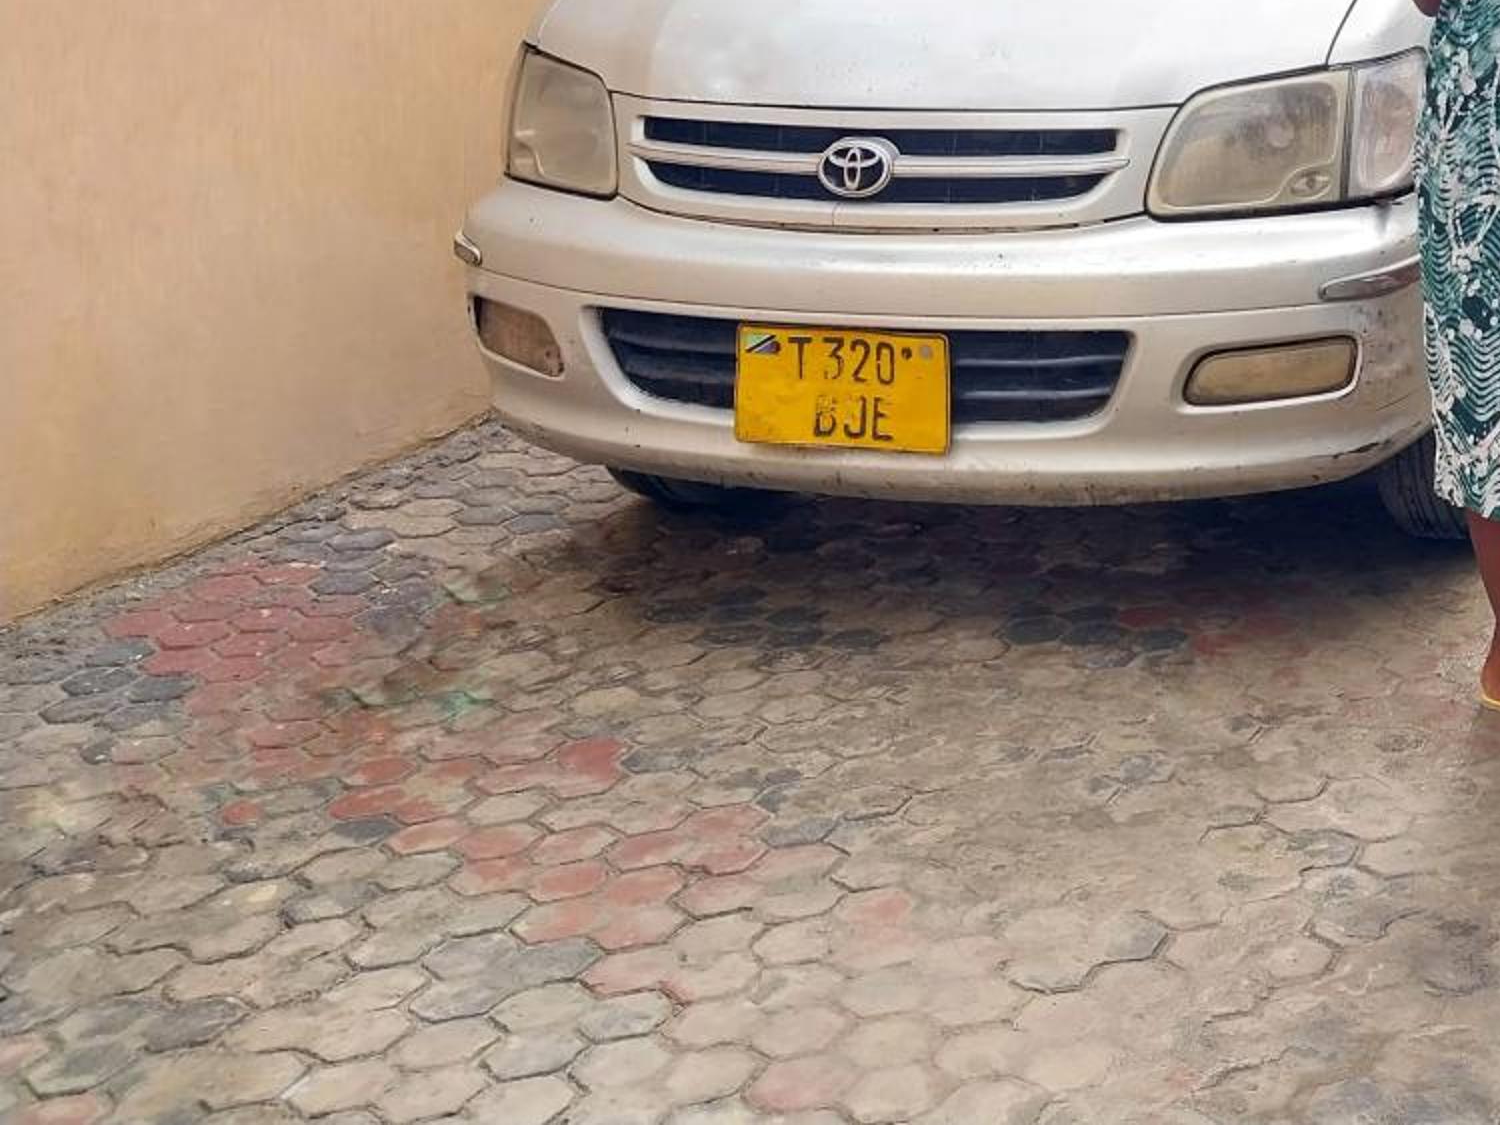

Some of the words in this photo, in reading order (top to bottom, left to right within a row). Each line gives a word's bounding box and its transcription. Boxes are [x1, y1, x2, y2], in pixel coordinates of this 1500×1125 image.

[787, 336, 813, 380] T
[821, 336, 895, 385] 320
[813, 394, 894, 441] BJE
